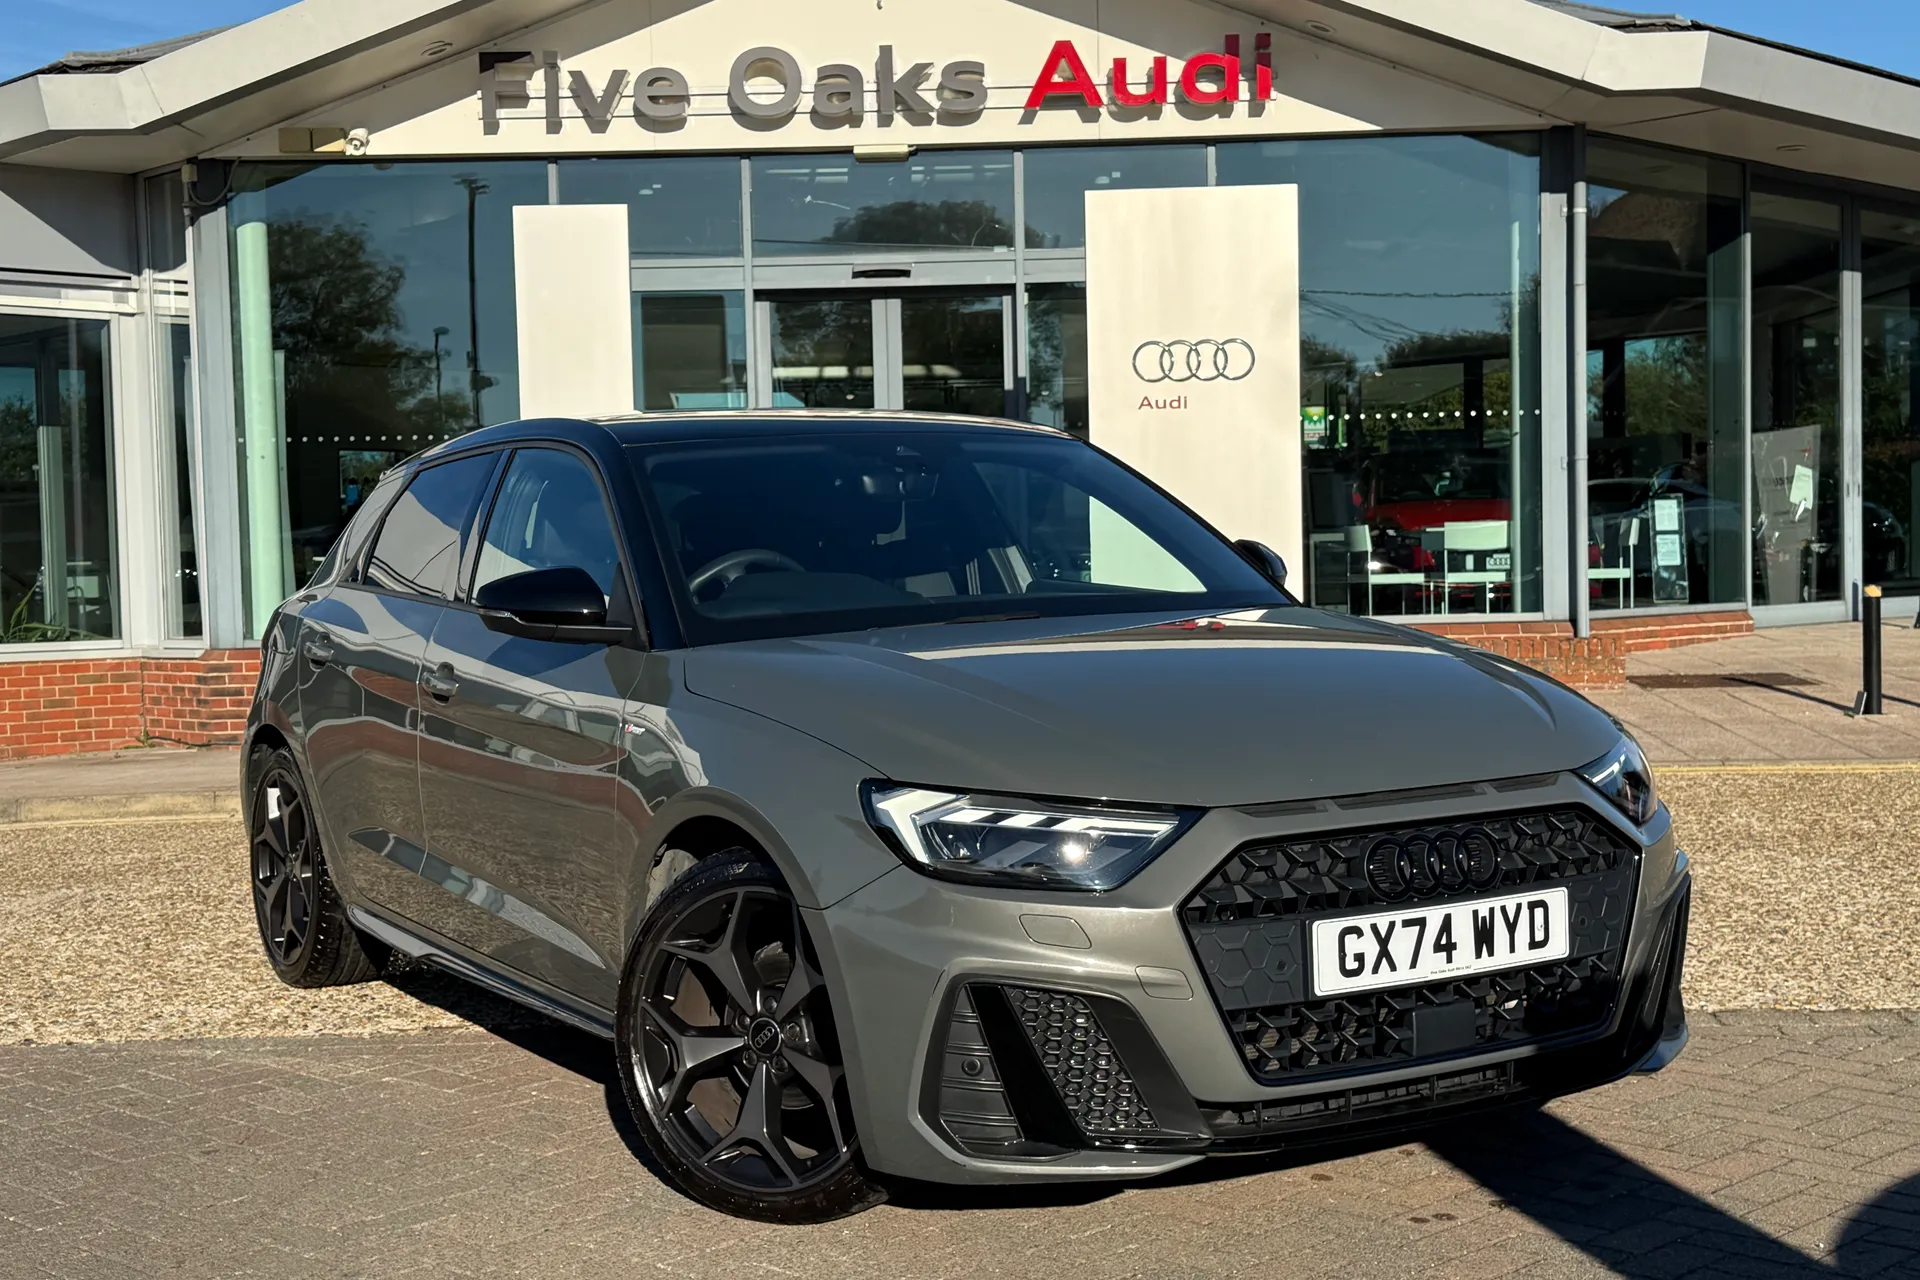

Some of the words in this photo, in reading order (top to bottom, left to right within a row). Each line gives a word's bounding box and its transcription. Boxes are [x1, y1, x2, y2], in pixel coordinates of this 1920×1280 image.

[478, 51, 690, 122] Five
[729, 44, 989, 119] Oaks
[1024, 33, 1273, 109] Audi
[1137, 395, 1188, 410] Audi
[1337, 912, 1458, 979] GX74
[1471, 898, 1550, 960] WYD
